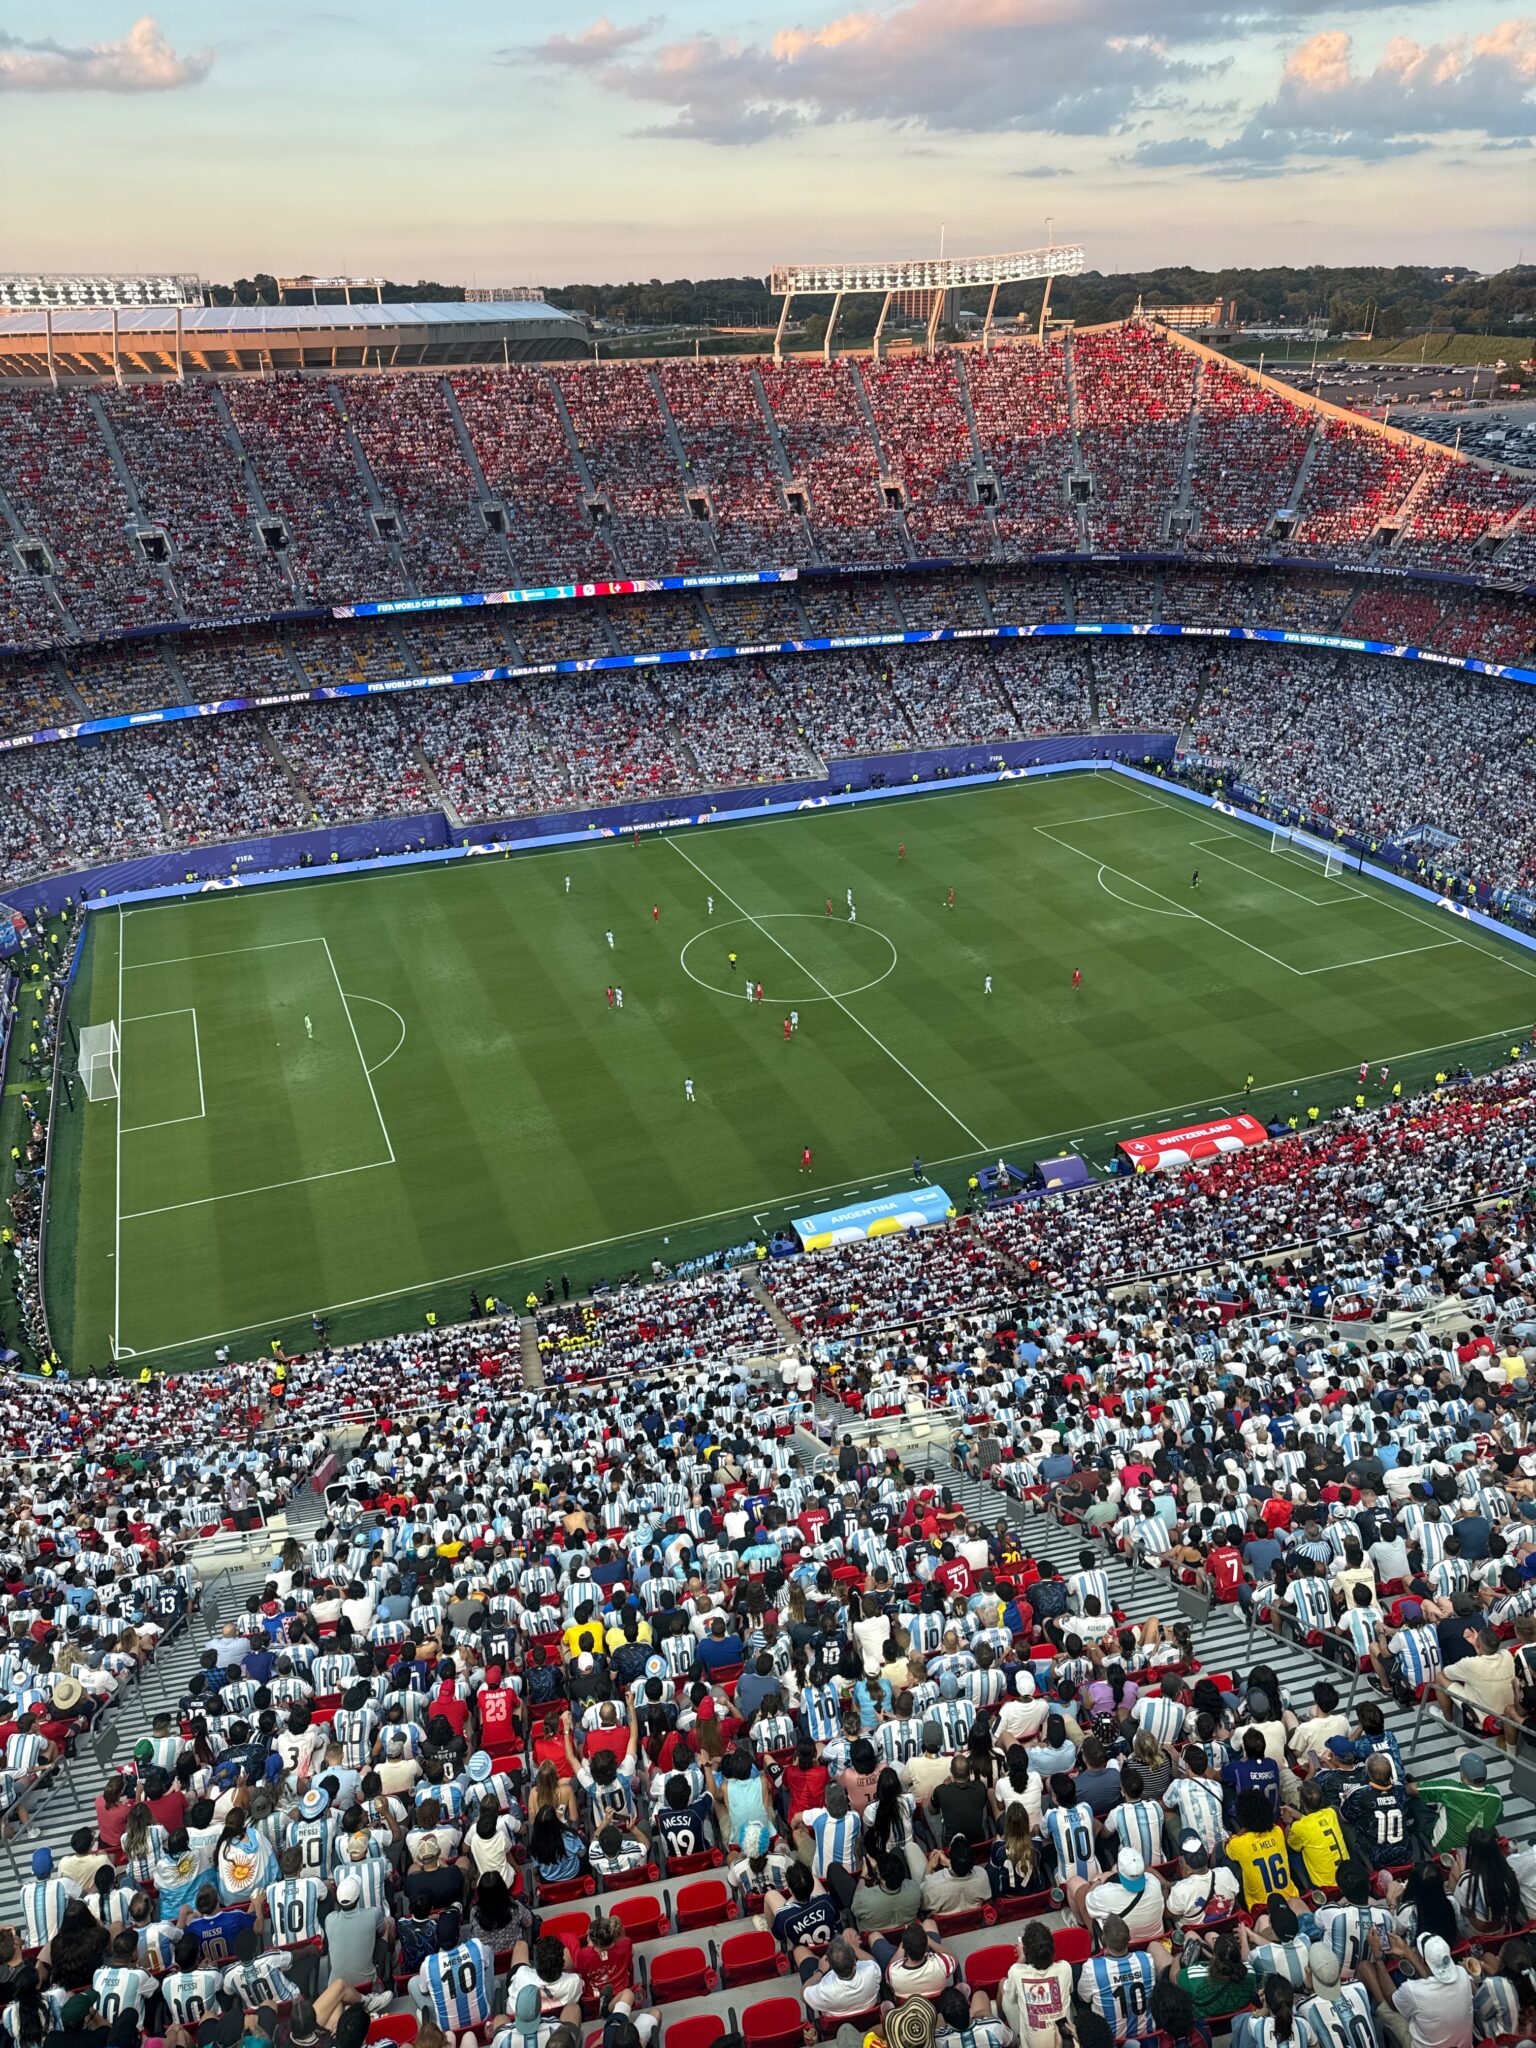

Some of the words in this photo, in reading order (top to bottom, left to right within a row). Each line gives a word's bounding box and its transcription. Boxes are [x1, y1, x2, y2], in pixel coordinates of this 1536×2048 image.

[1335, 564, 1381, 574] KANSAS
[1383, 568, 1408, 576] CITY
[557, 587, 566, 597] 1
[378, 604, 394, 612] FIFA
[395, 602, 420, 610] WORLD
[421, 600, 436, 608] CUP
[190, 618, 241, 630] KANSAS
[243, 614, 271, 624] CITY
[831, 639, 846, 647] FIFA
[1300, 635, 1325, 644] WORLD
[1326, 637, 1340, 646] CUP
[1418, 652, 1448, 663] KANSAS
[1448, 657, 1466, 666] CITY
[368, 683, 384, 691] FIFA
[385, 681, 411, 689] WORLD
[413, 679, 427, 687] CUP
[256, 694, 290, 706] KANSAS
[291, 692, 310, 702] CITY
[12, 735, 33, 746] CITY
[1288, 805, 1298, 813] FIFA
[633, 823, 655, 831] WORLD
[1157, 1124, 1232, 1145] SWITZERLAND
[831, 1202, 898, 1224] ARGENTINA
[1202, 1352, 1214, 1363] 22
[1012, 1472, 1028, 1486] 10
[668, 1492, 680, 1506] 10
[781, 1497, 794, 1512] 19
[200, 1510, 210, 1522] 10
[1489, 1498, 1508, 1518] 10
[844, 1519, 858, 1536] 10
[315, 1548, 326, 1562] 10
[718, 1562, 732, 1577] 10
[1226, 1559, 1238, 1582] 7
[948, 1572, 968, 1591] 37
[1449, 1573, 1468, 1592] 10
[72, 1596, 82, 1611] 5
[118, 1602, 135, 1618] 15
[160, 1596, 176, 1614] 13
[1306, 1593, 1328, 1615] 10
[924, 1629, 938, 1650] 10
[672, 1651, 690, 1672] 10
[822, 1648, 840, 1664] 10
[1421, 1646, 1439, 1668] 10
[321, 1666, 339, 1681] 10
[486, 1699, 506, 1721] 23
[814, 1697, 835, 1720] 10
[341, 1725, 362, 1744] 10
[945, 1722, 967, 1747] 10
[1373, 1743, 1390, 1752] KANE
[288, 1747, 299, 1771] 3
[1377, 1796, 1396, 1805] MESSI
[663, 1816, 691, 1829] MESSI
[1064, 1815, 1085, 1823] MESSI
[1374, 1809, 1403, 1844] 10
[667, 1832, 694, 1856] 19
[1065, 1827, 1091, 1863] 10
[1260, 1839, 1276, 1849] MELO
[1004, 1859, 1032, 1887] 19
[1253, 1853, 1288, 1892] 16
[278, 1900, 304, 1932] 10
[793, 1910, 825, 1932] MESSI
[202, 1927, 222, 1938] MESSI
[202, 1938, 227, 1961] 10
[443, 1953, 469, 1968] MESSI
[441, 1962, 476, 1998] 10
[1114, 1972, 1142, 1984] MESSI
[177, 1983, 197, 1992] MESSI
[241, 1978, 274, 2007] 10
[1112, 1982, 1146, 2018] 10
[1330, 2000, 1354, 2016] MESSI
[174, 1996, 205, 2023] 10
[1331, 2015, 1377, 2048] 10
